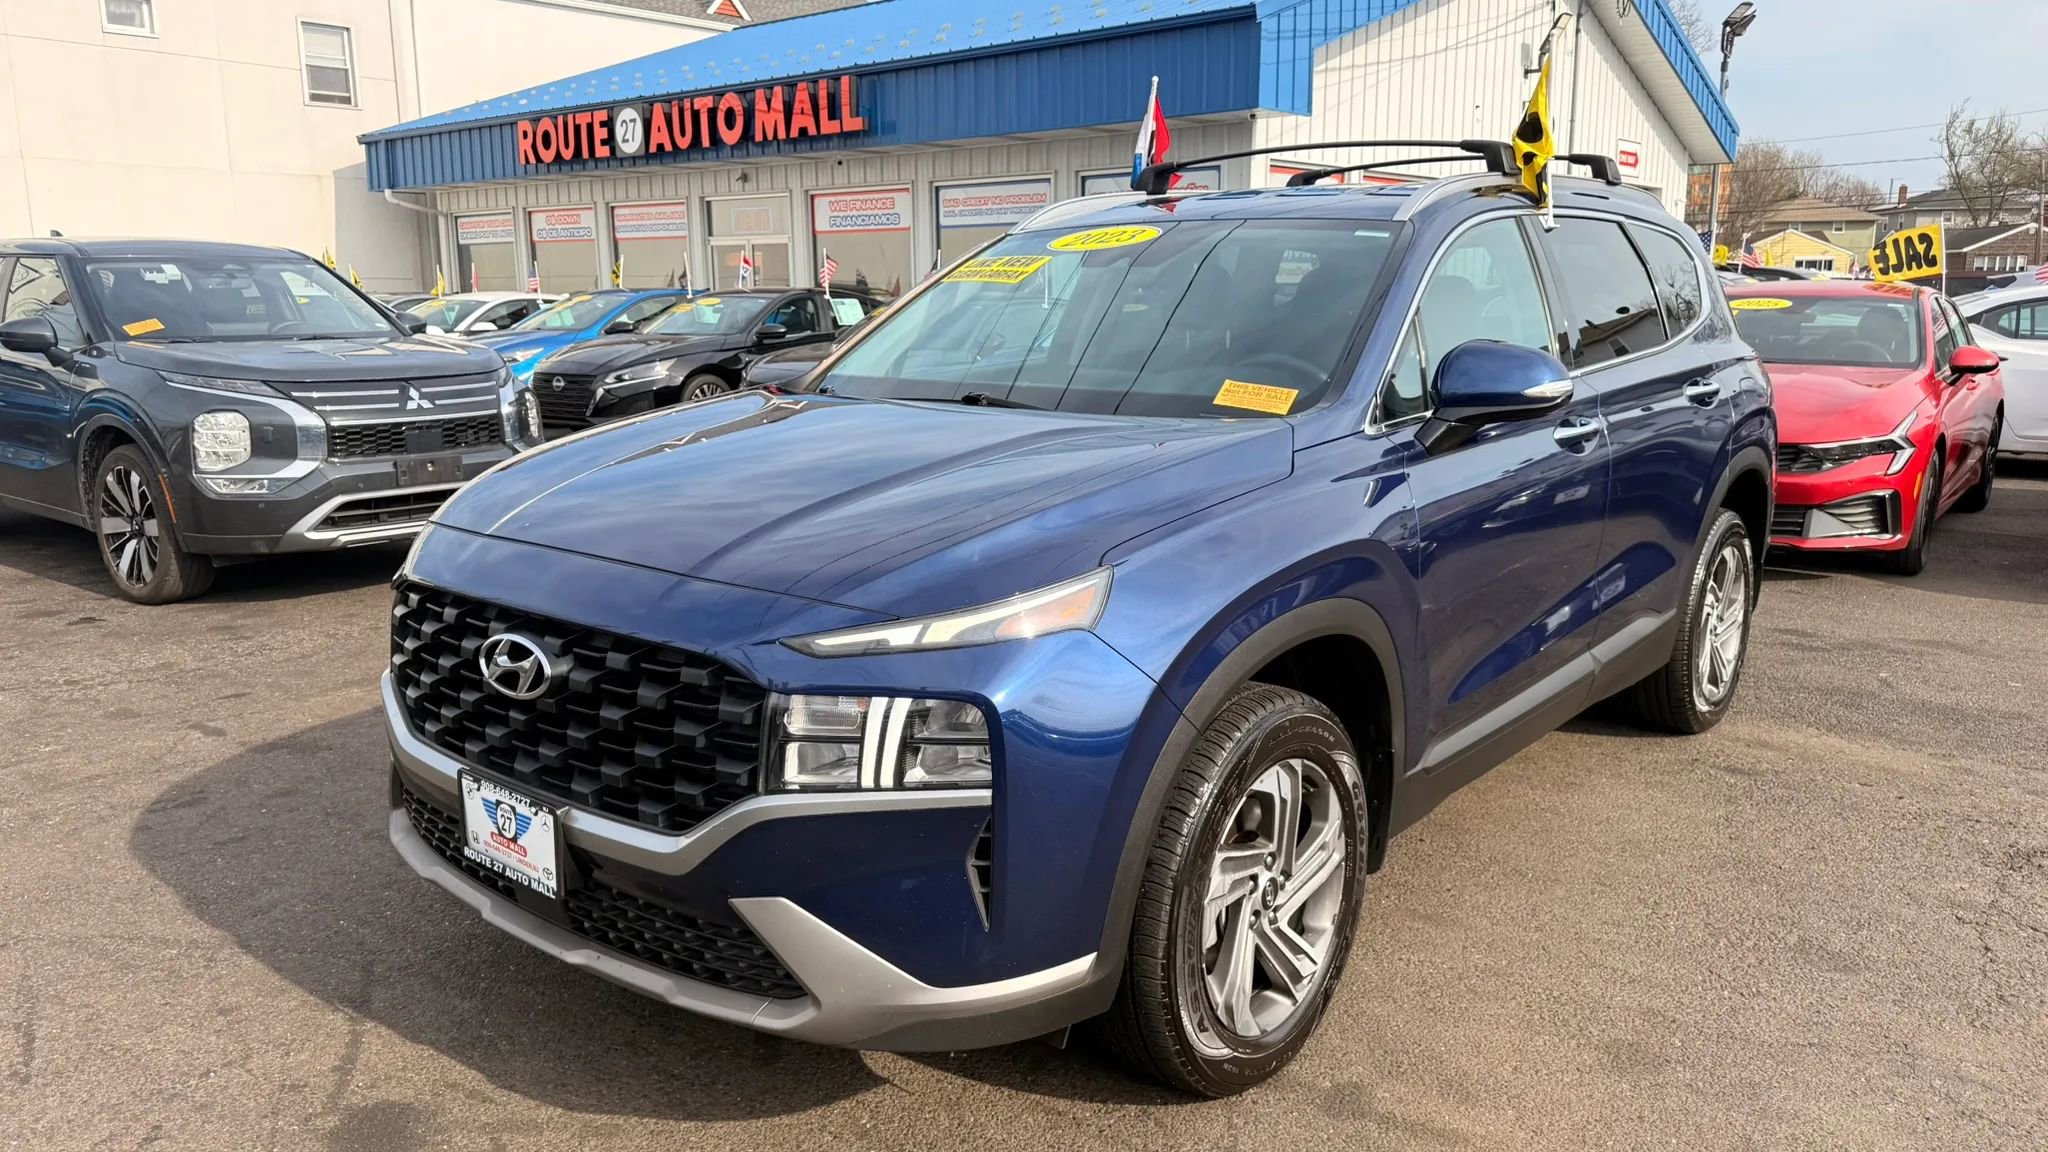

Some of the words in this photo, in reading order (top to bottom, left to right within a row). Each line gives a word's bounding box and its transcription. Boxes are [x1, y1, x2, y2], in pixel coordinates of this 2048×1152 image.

[517, 109, 611, 165] ROUTE
[620, 117, 638, 144] 27
[649, 92, 746, 153] AUTO
[754, 75, 865, 142] MALL
[830, 200, 849, 212] WE
[850, 197, 895, 210] FINANCE
[943, 197, 960, 208] BAD
[962, 196, 989, 207] CREDIT
[991, 195, 1004, 205] NO
[1005, 192, 1047, 204] PROBLEM
[558, 213, 581, 225] DOWN
[830, 212, 900, 228] FINANCIAMOS
[548, 228, 559, 239] DE
[559, 227, 592, 238] ANTICIPO
[1062, 228, 1147, 247] 2023
[997, 256, 1045, 267] NEW
[1228, 382, 1249, 391] THIS
[1252, 384, 1294, 396] VEHICLE
[1243, 389, 1263, 399] FOR
[1265, 392, 1292, 402] SALE
[500, 807, 513, 817] ROUTE
[500, 814, 513, 834] 27
[492, 833, 509, 848] AUTO
[509, 842, 526, 856] MALL
[464, 846, 492, 868] ROUTE
[492, 861, 503, 874] 27
[505, 867, 529, 886] AUTO
[531, 878, 556, 900] MALL
